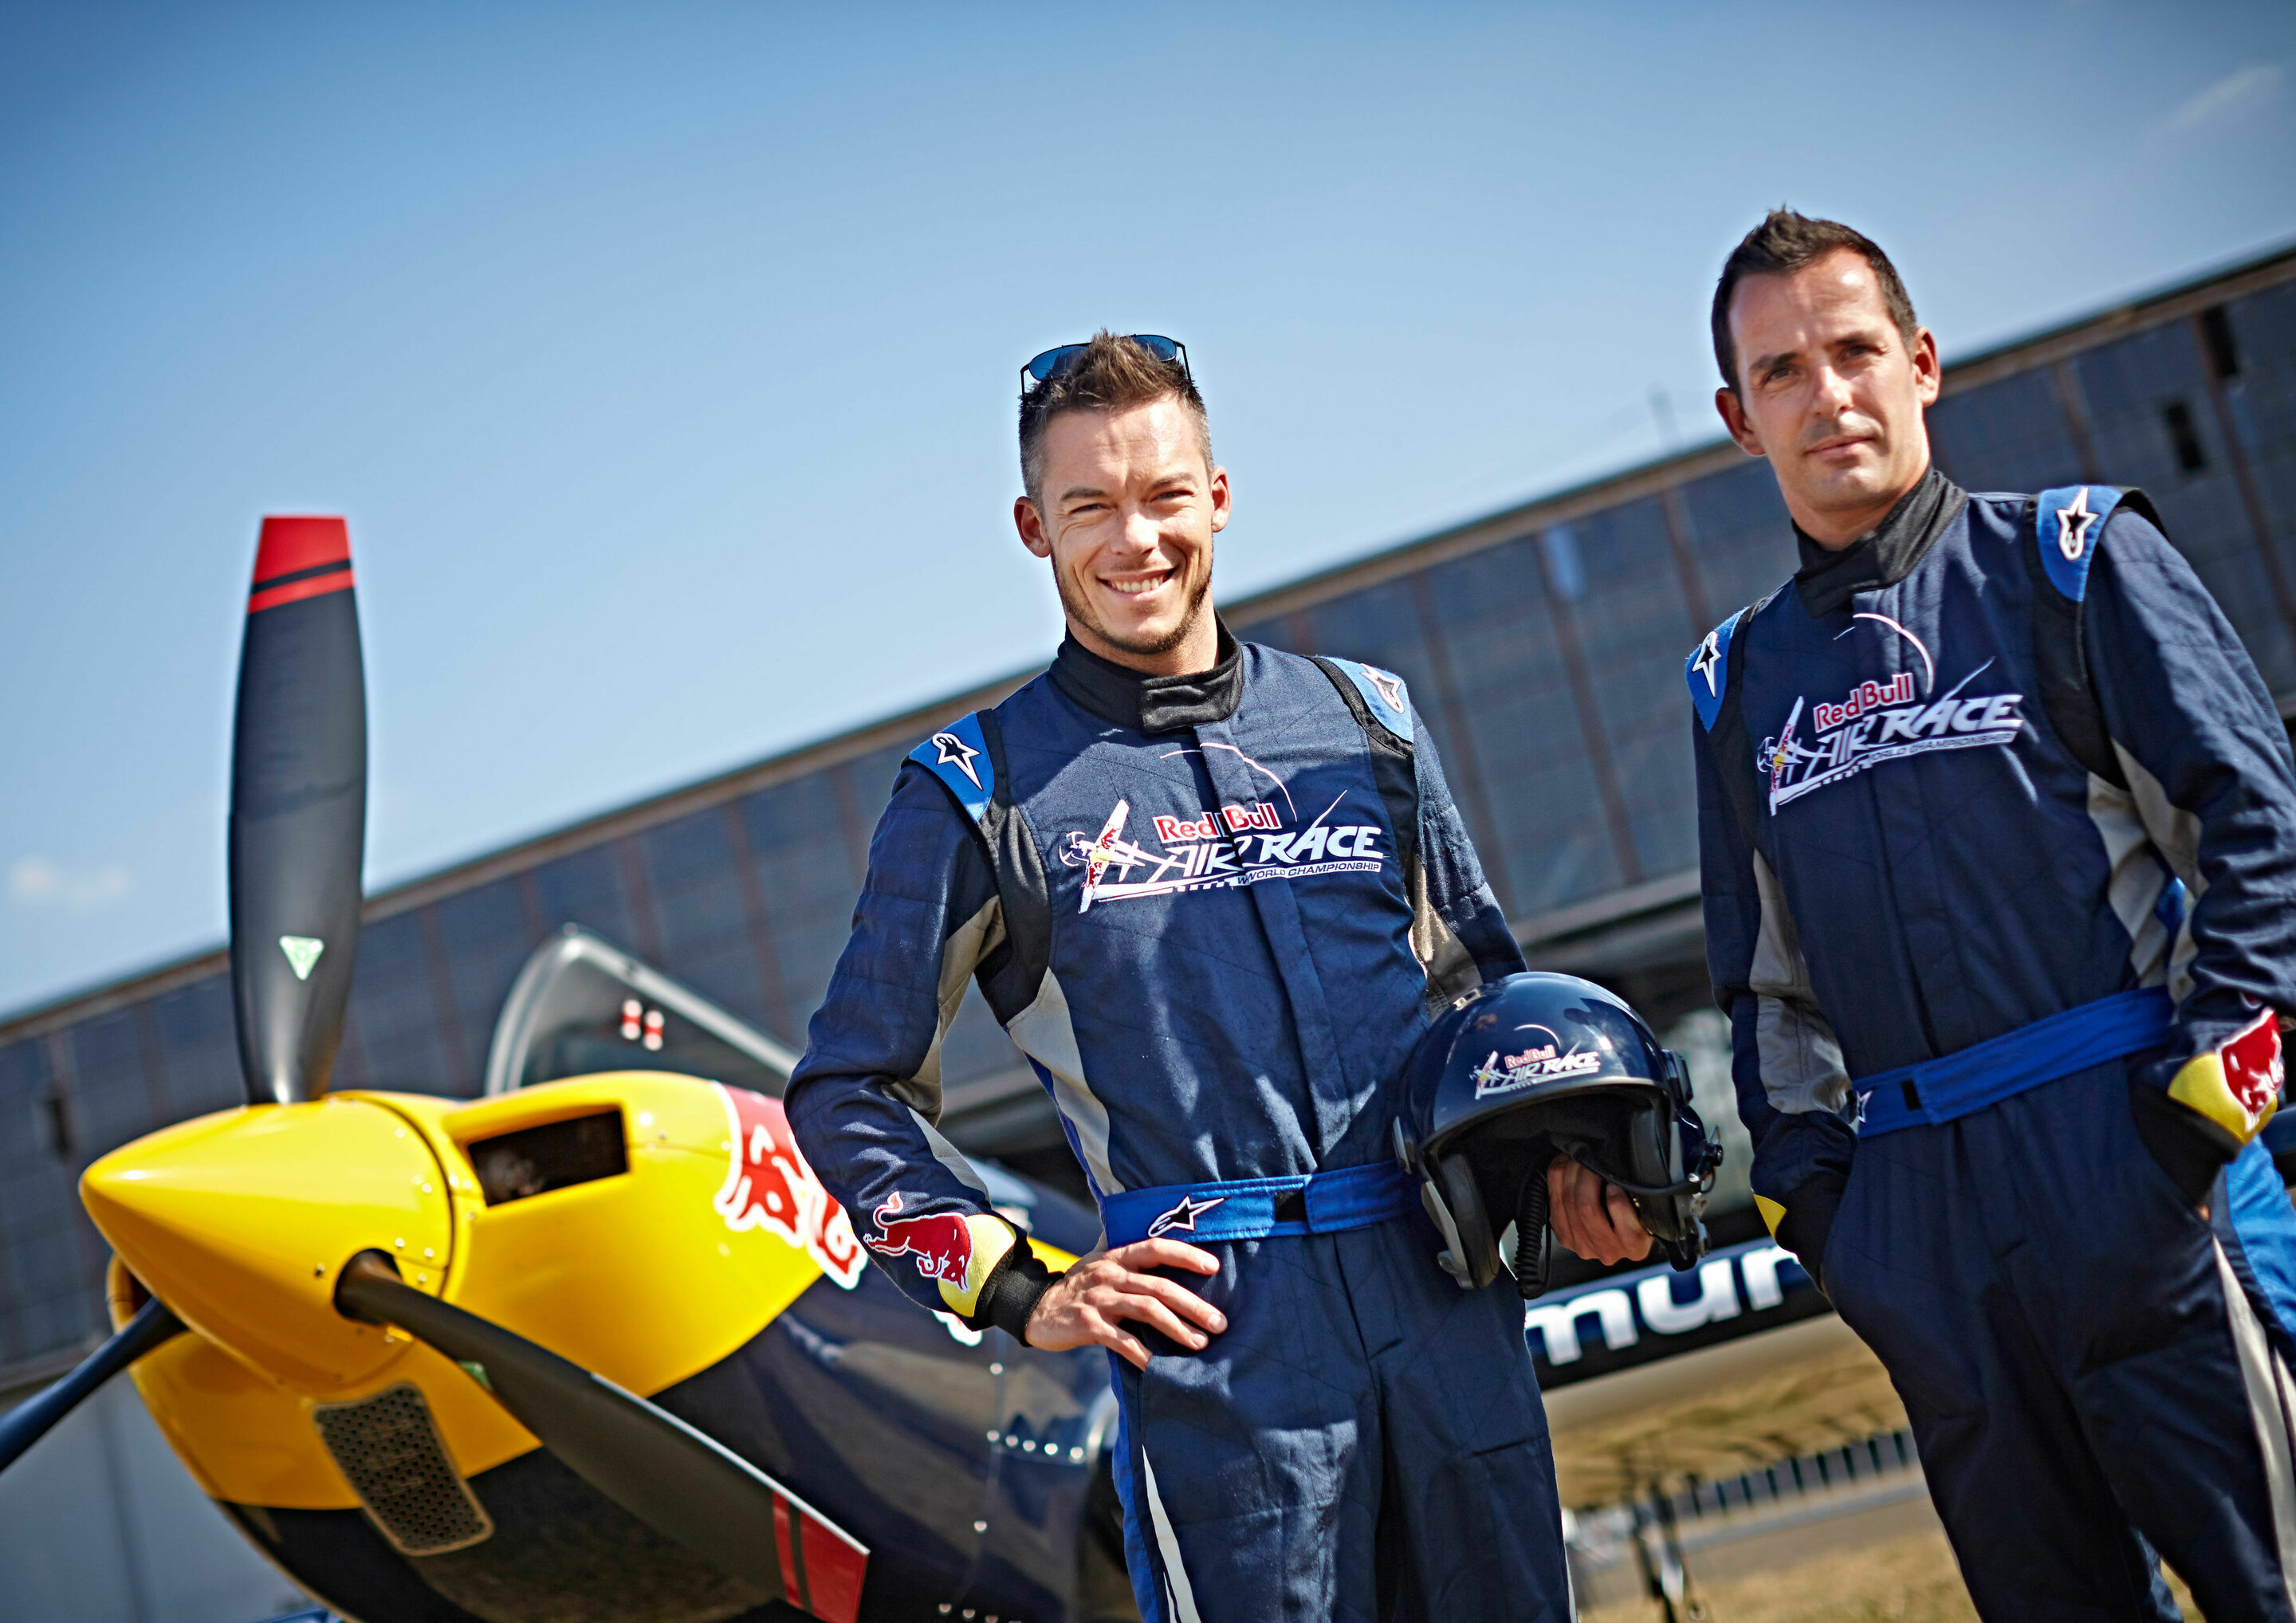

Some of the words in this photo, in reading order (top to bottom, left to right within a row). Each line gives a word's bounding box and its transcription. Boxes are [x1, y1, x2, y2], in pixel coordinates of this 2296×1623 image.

[1813, 689, 1863, 733] Red
[1860, 673, 1915, 710] Bull
[1877, 694, 2023, 744] RACE
[1152, 812, 1221, 843] Red
[1221, 802, 1283, 833] Bull
[1146, 835, 1252, 883] AIR
[1252, 825, 1384, 864] RACE
[1288, 862, 1380, 877] CHAMPIONSHIP
[1504, 1049, 1531, 1069] Red
[1529, 1043, 1556, 1063] Bull
[1540, 1051, 1601, 1073] RACE
